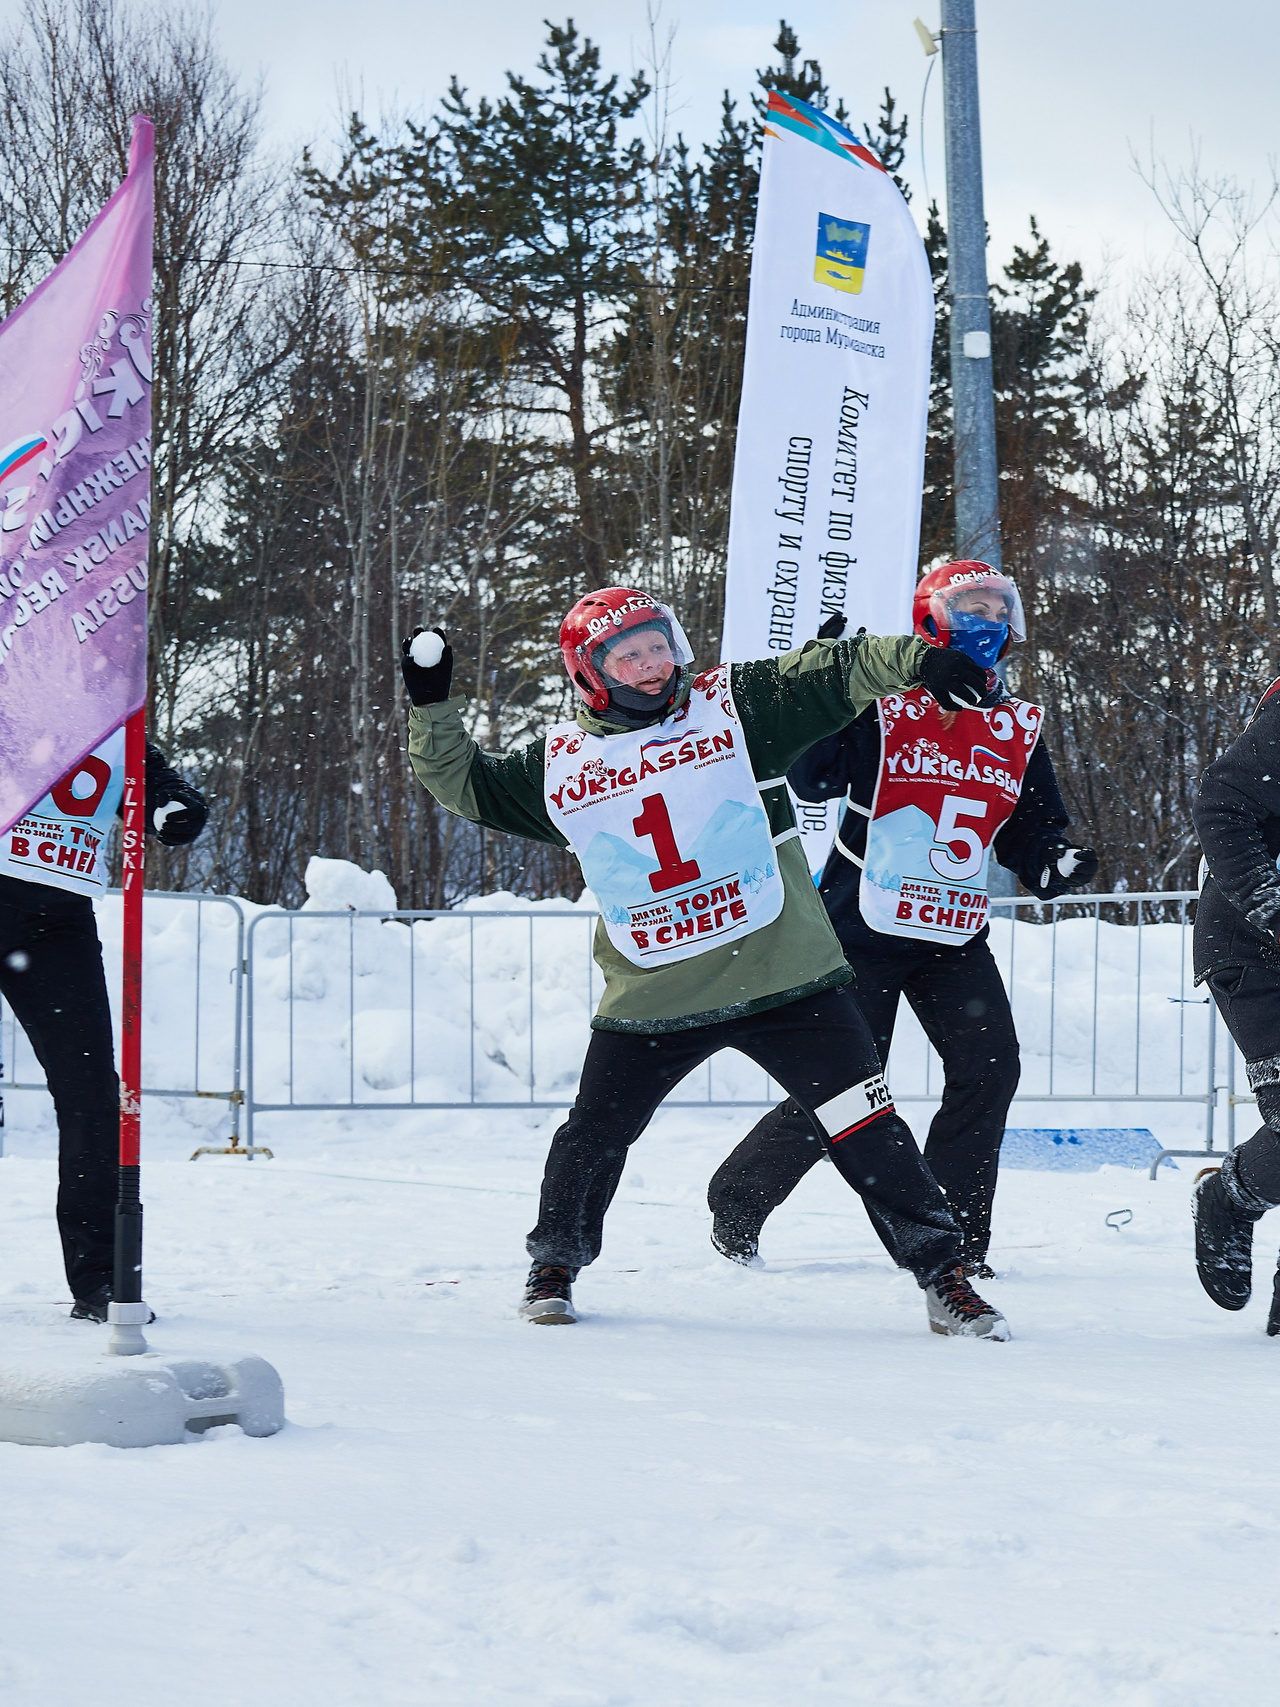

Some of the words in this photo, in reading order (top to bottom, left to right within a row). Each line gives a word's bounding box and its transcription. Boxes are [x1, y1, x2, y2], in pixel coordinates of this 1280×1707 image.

[780, 325, 821, 343] города
[831, 386, 869, 503] Комитет
[775, 436, 813, 525] спорту
[827, 510, 853, 541] по
[778, 533, 802, 551] и
[818, 550, 857, 618] физи
[767, 559, 800, 651] охране
[33, 829, 64, 841] ЗНАЕТ
[40, 823, 65, 833] ТЕХ,
[122, 787, 138, 891] LISKI
[632, 792, 701, 893] 1
[929, 794, 988, 881] 5
[11, 836, 30, 857] В
[675, 880, 741, 916] ТОЛК
[901, 883, 921, 892] ДЛЯ
[922, 886, 942, 896] ТЕХ,
[916, 894, 941, 903] ЗНАЕТ
[631, 911, 649, 922] ДЛЯ
[649, 905, 671, 917] ТЕХ,
[631, 931, 649, 949] В
[656, 899, 747, 944] СНЕГЕ
[649, 914, 673, 926] ЗНАЕТ
[896, 901, 913, 919] В
[919, 904, 986, 930] СНЕГЕ
